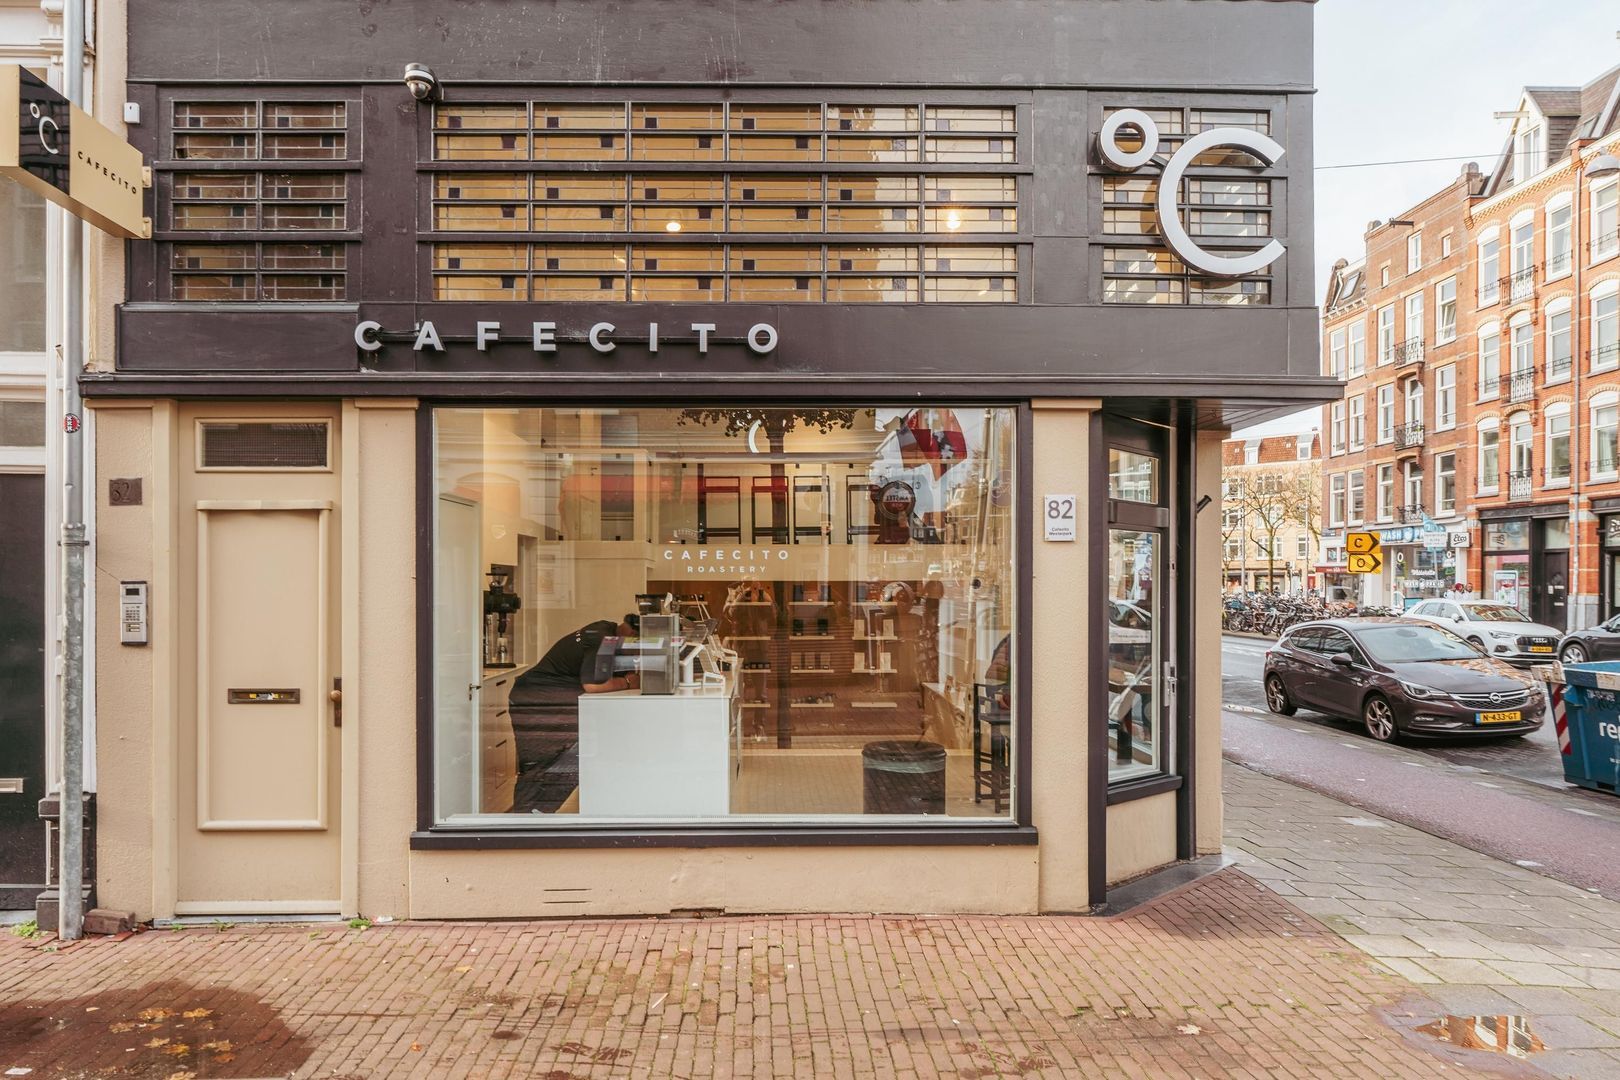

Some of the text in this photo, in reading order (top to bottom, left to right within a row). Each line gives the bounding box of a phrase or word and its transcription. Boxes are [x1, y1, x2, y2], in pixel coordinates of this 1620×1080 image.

[77, 151, 137, 194] CAFECITO
[354, 320, 778, 354] CAFECITO
[1048, 499, 1073, 519] 82
[1354, 537, 1363, 548] C
[664, 550, 789, 560] CAFECITO
[1482, 711, 1518, 722] N-433-GT
